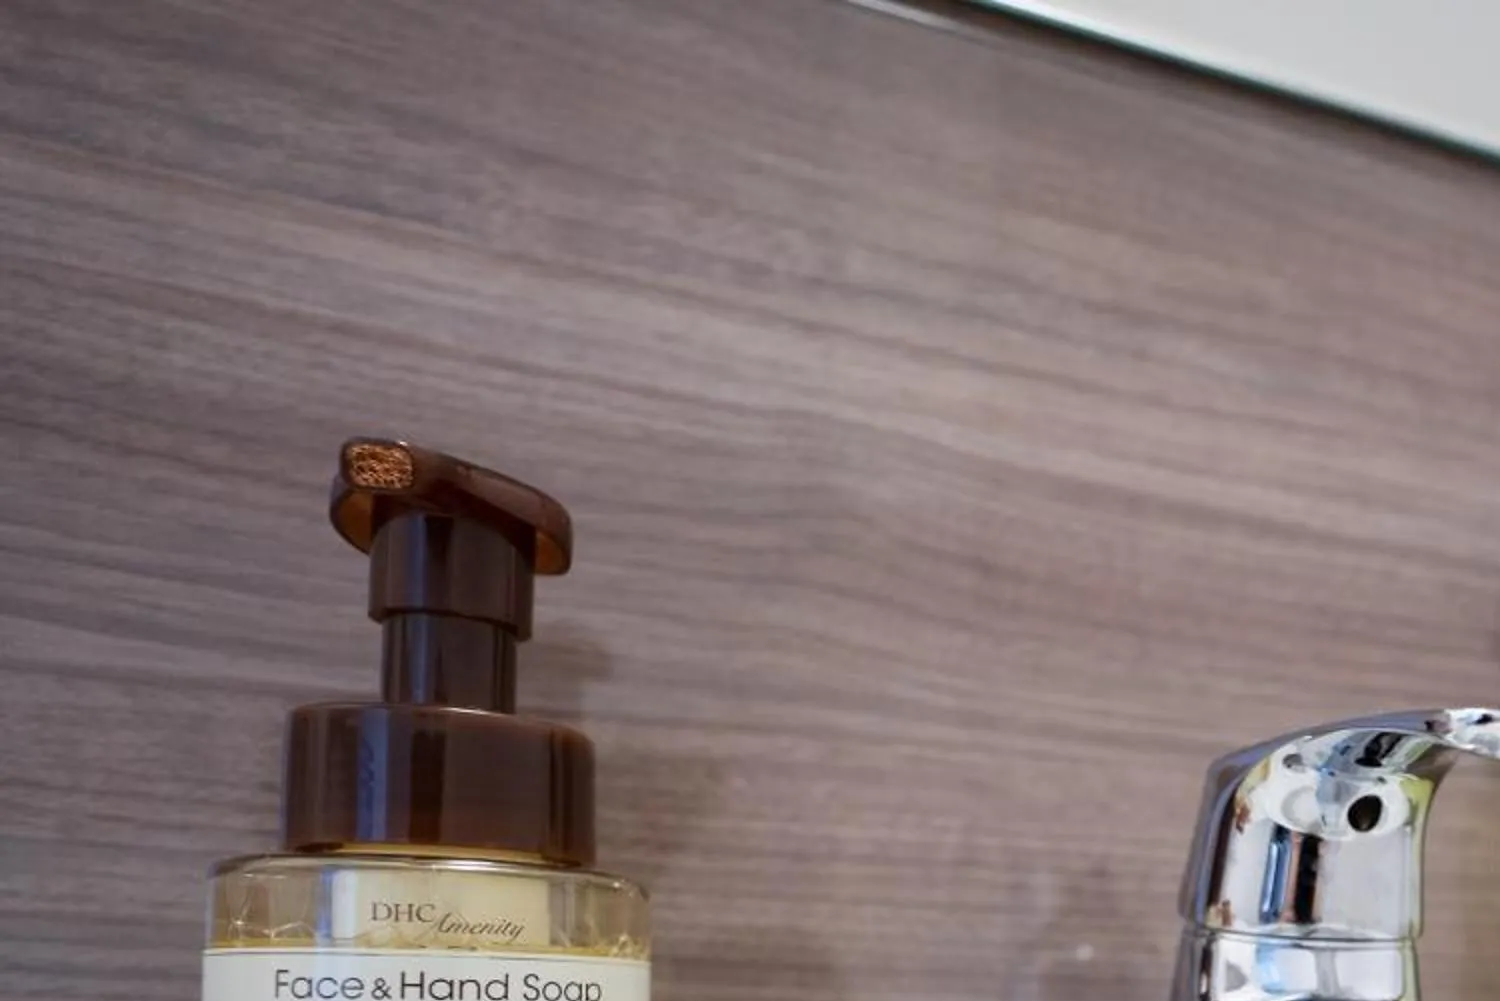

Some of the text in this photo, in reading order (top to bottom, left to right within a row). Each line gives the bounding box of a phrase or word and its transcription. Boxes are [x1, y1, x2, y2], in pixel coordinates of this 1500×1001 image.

[371, 901, 525, 942] DHC Amenity
[275, 969, 365, 1000] Face
[370, 977, 393, 1001] &
[399, 971, 509, 1001] Hand
